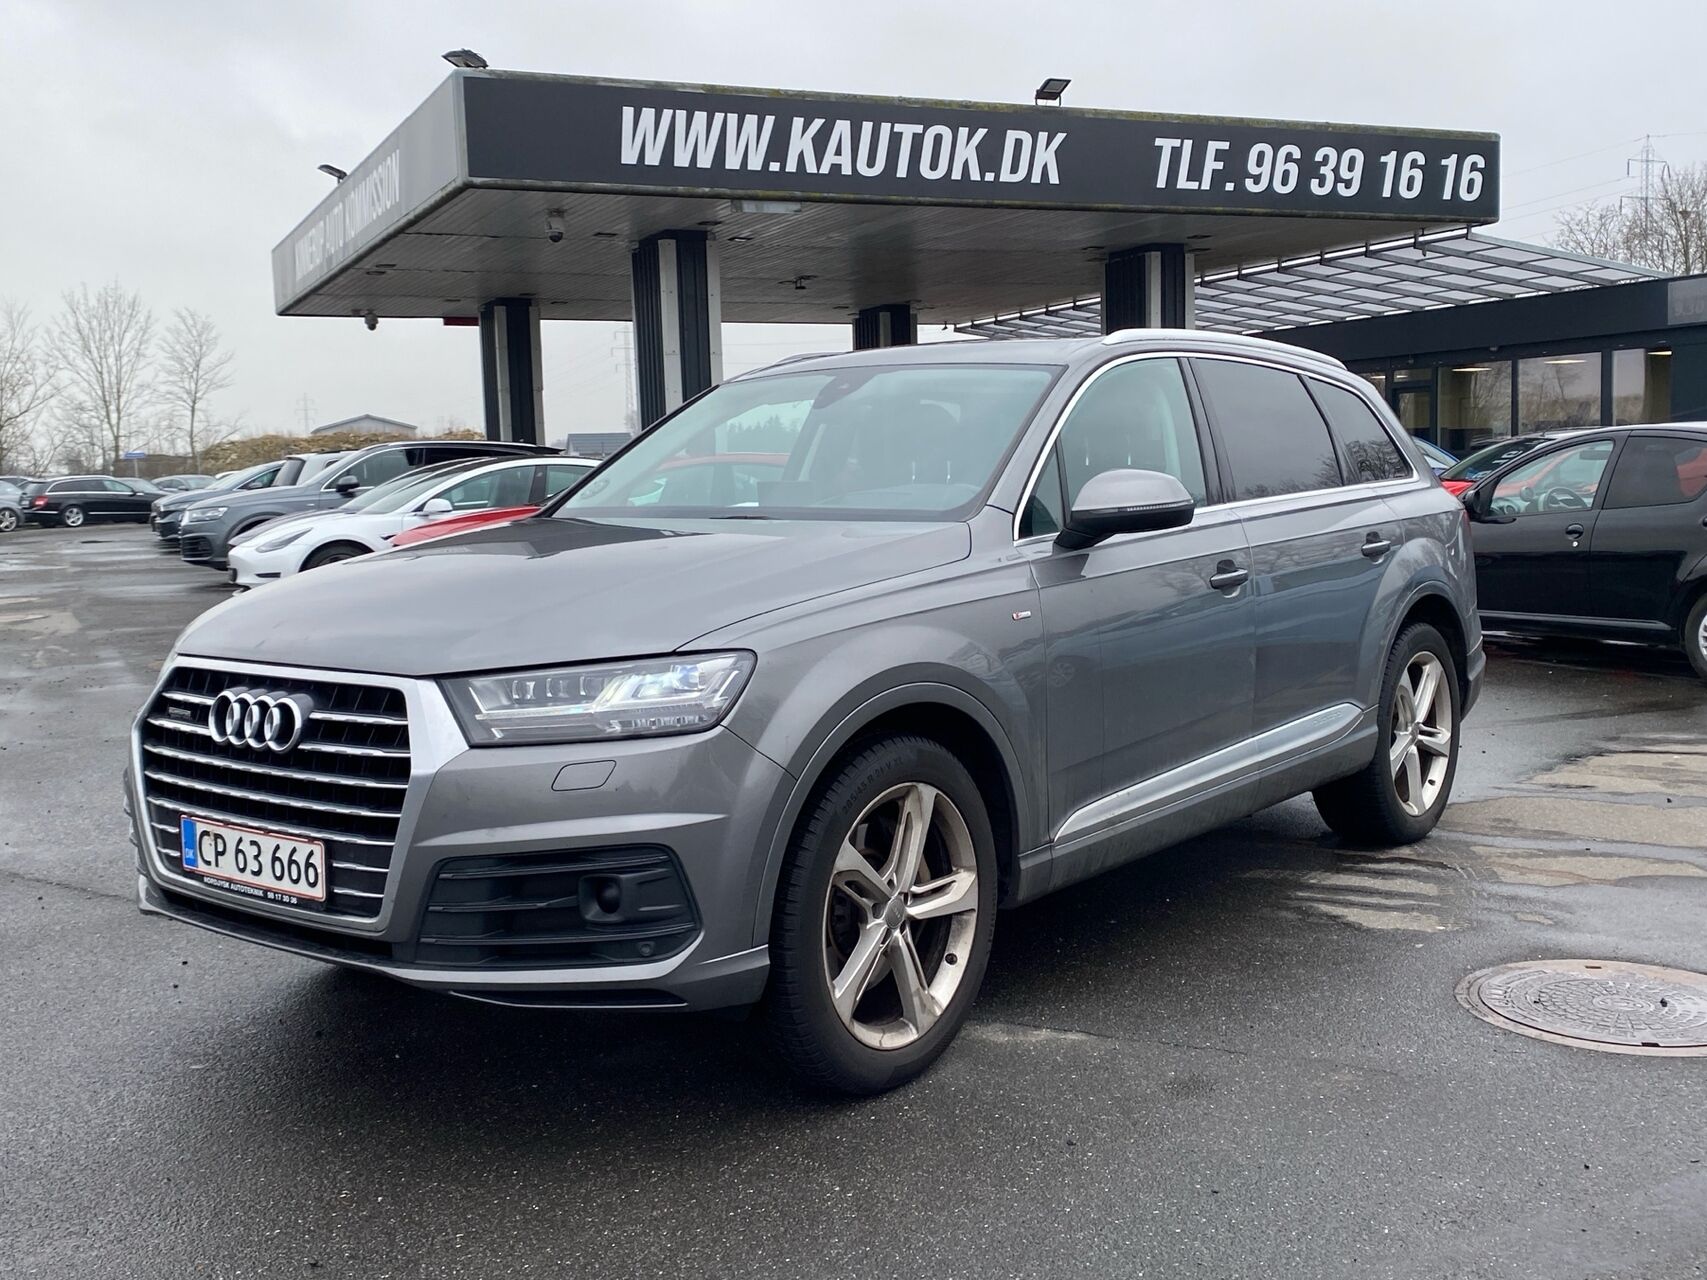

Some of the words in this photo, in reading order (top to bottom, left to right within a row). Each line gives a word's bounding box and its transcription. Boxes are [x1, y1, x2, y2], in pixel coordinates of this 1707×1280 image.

[620, 105, 1067, 185] WWW.KAUTOK.DK
[1154, 137, 1236, 192] TLF.
[1244, 142, 1301, 195] 96
[1310, 146, 1365, 197] 39
[1380, 150, 1426, 199] 16
[1440, 153, 1486, 202] 16
[345, 148, 400, 242] KOMMISSION
[198, 829, 227, 868] CP
[235, 836, 263, 877] 63
[271, 843, 319, 888] 666
[230, 883, 264, 897] AUTOTEKNIK
